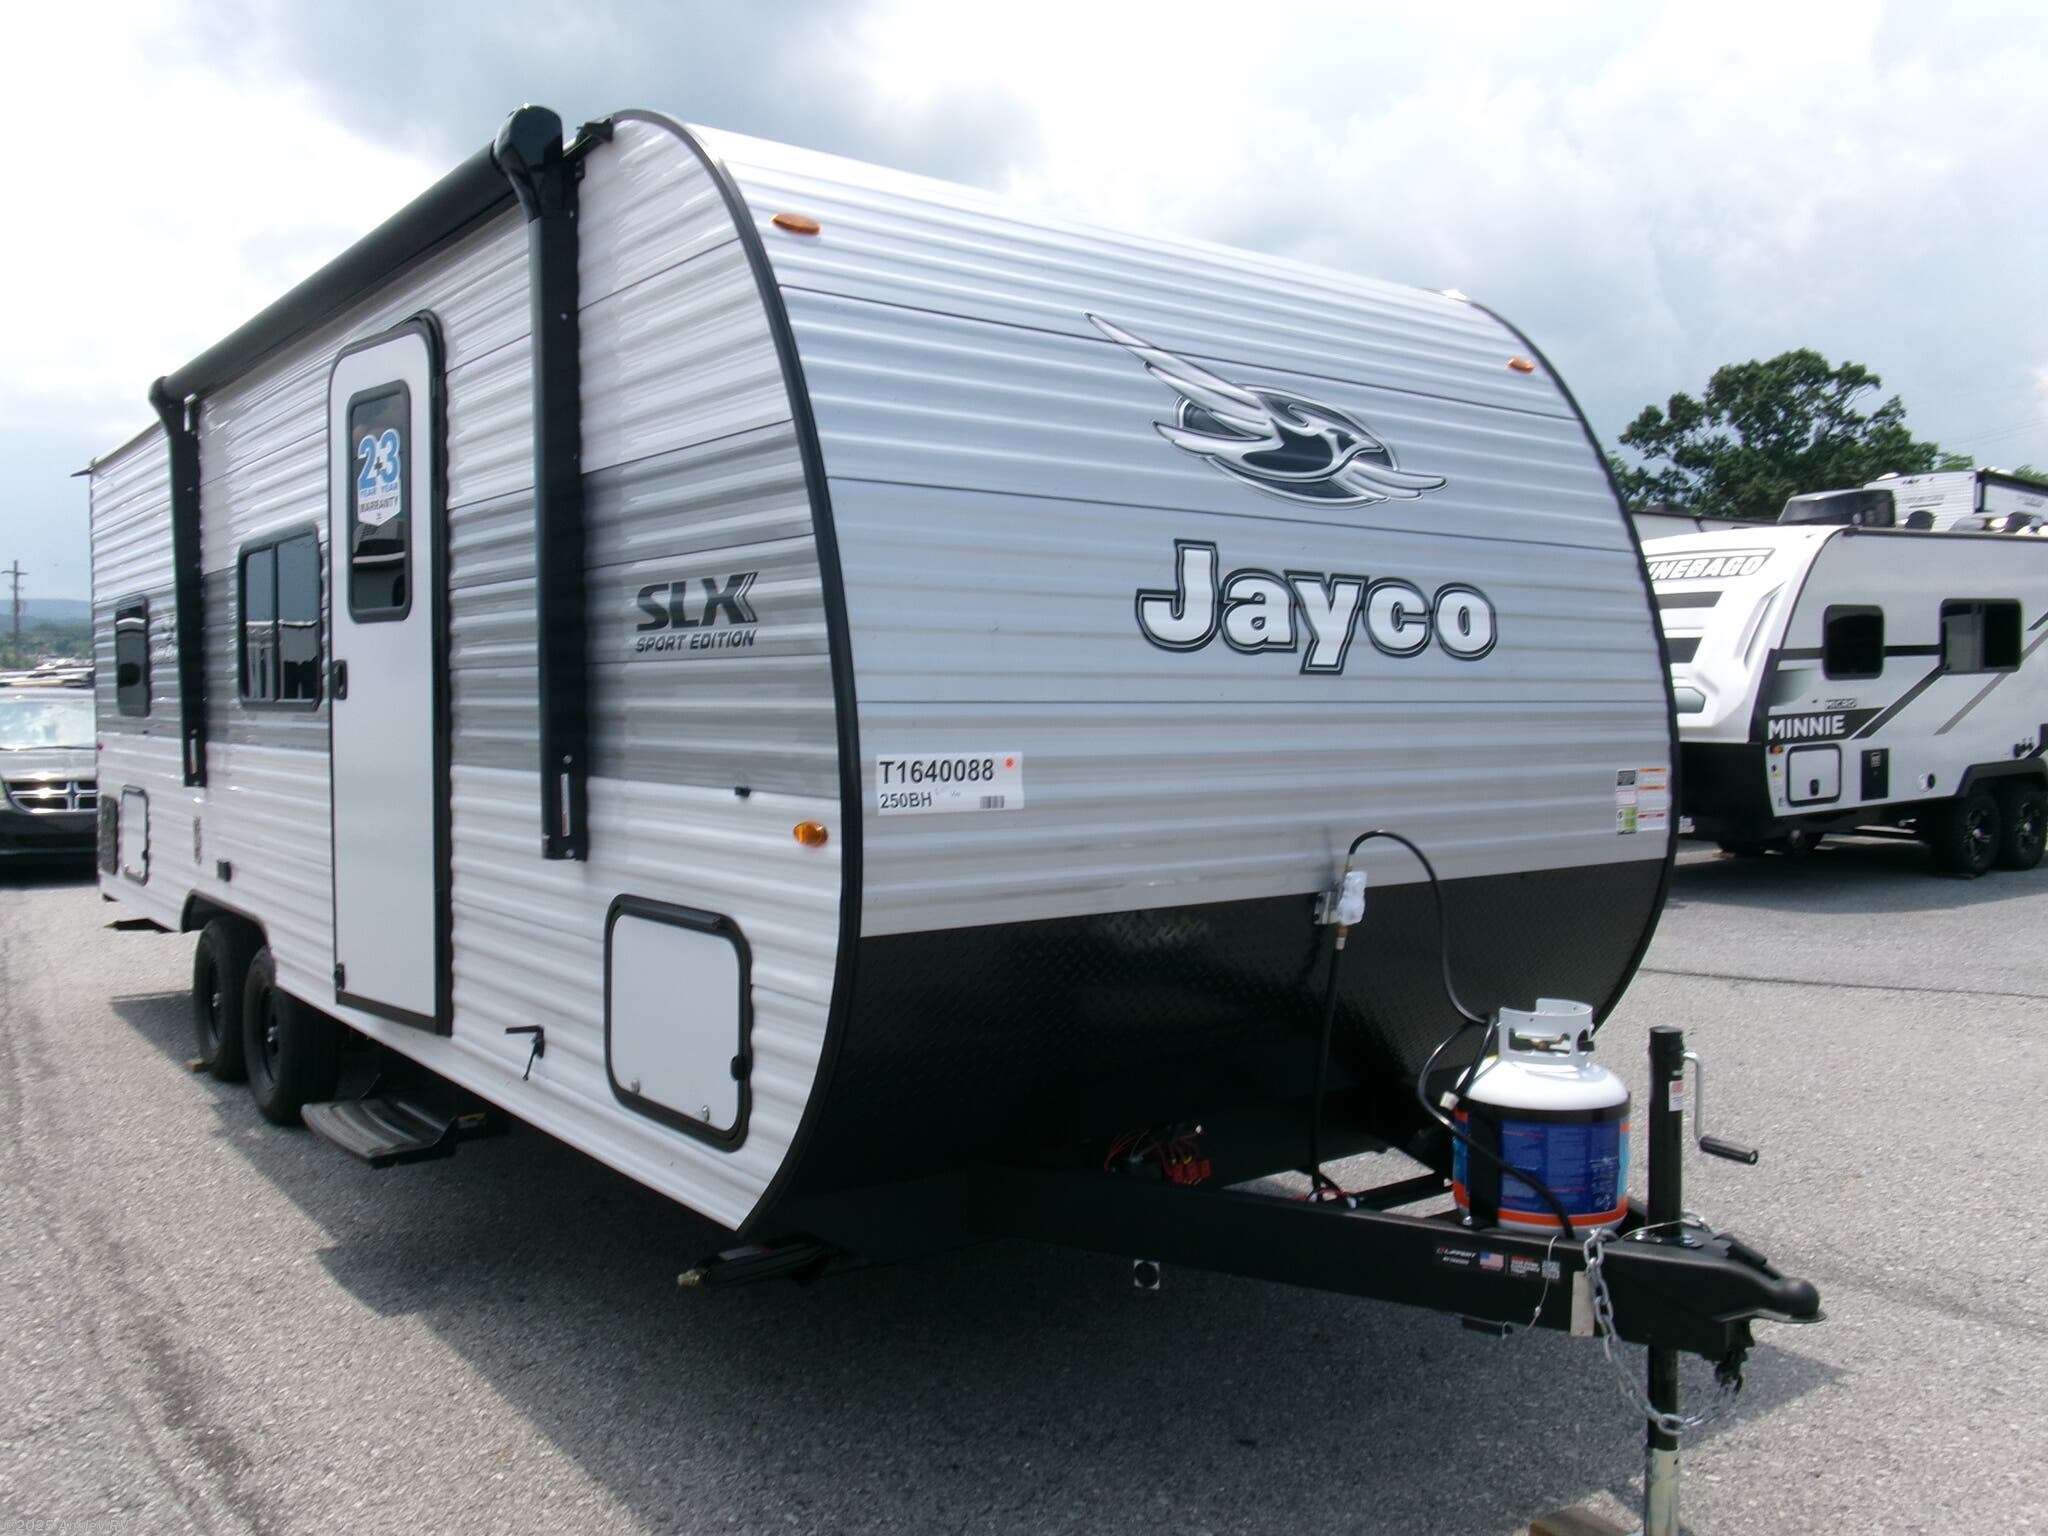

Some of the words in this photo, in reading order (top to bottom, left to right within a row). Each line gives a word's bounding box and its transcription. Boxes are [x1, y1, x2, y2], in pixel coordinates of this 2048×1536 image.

[360, 496, 399, 512] WARRANTY
[637, 571, 759, 632] SLX
[1135, 538, 1498, 675] Jayco
[636, 634, 686, 653] SPORT
[690, 629, 757, 650] EDITION
[1768, 714, 1846, 740] MINNIE
[879, 759, 994, 784] T1640088
[880, 792, 932, 808] 250BH
